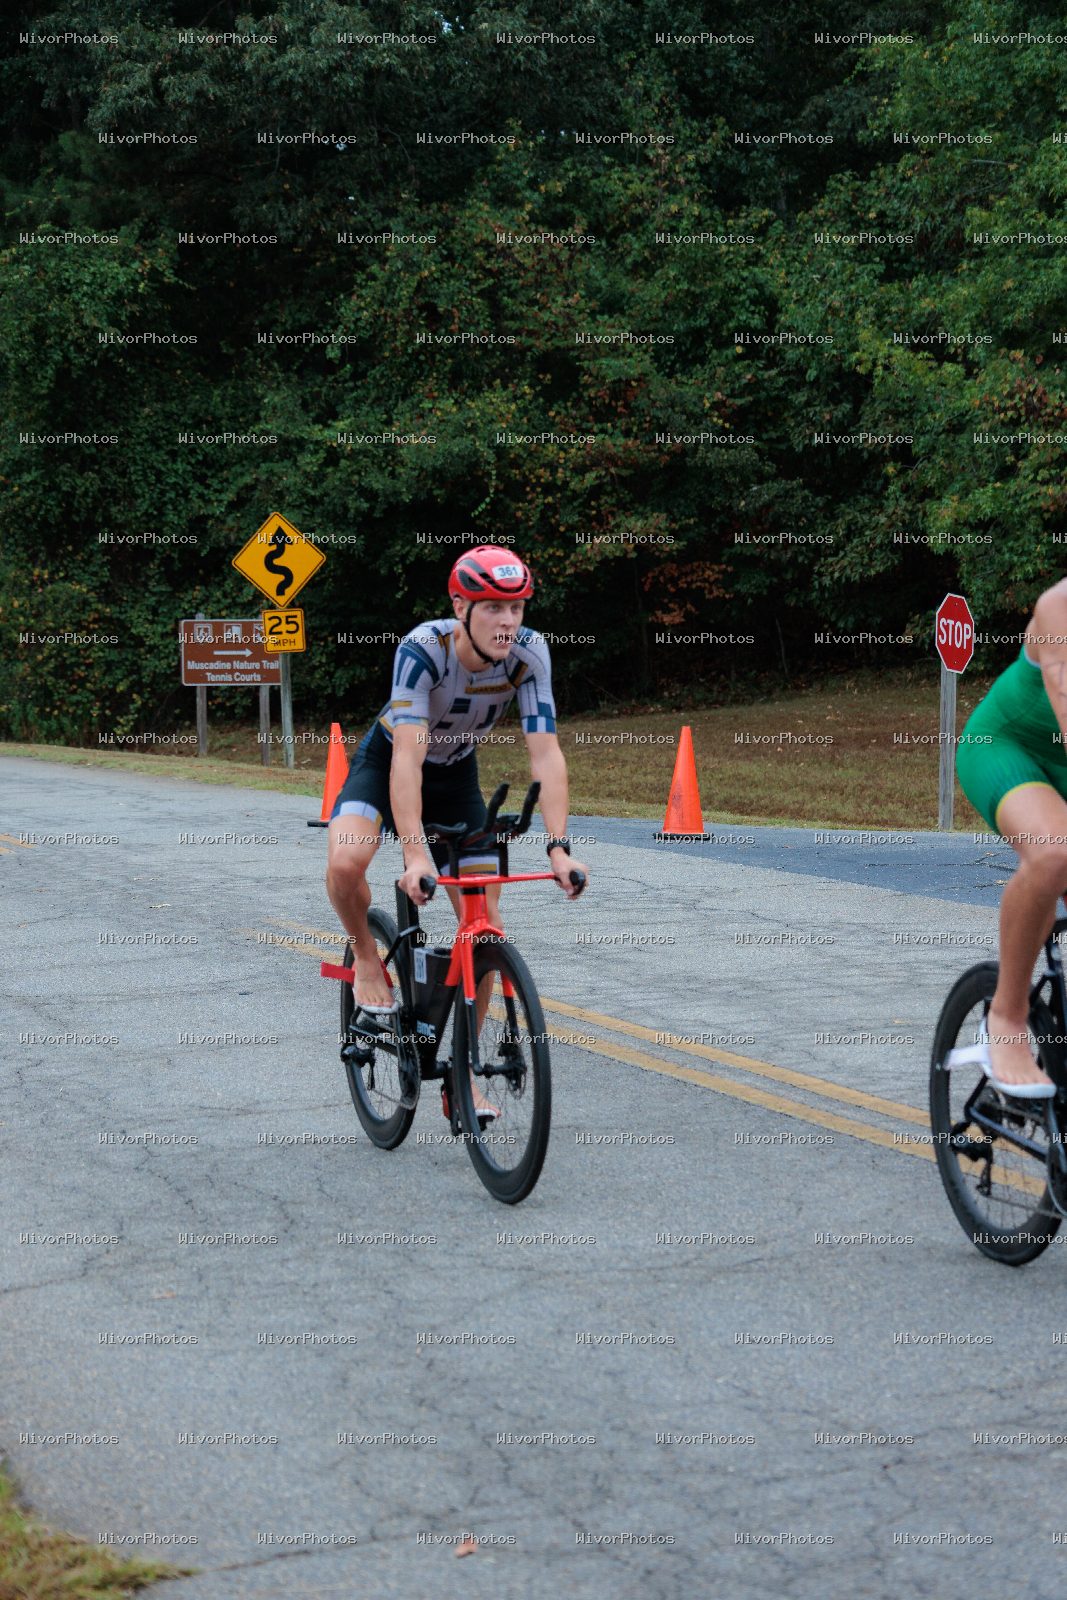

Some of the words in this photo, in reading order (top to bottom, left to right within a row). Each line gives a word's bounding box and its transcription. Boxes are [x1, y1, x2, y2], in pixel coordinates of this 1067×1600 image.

[497, 566, 518, 577] 361
[268, 615, 300, 635] 25
[938, 617, 972, 650] STOP
[273, 638, 297, 647] MPH
[187, 660, 231, 670] Muscadine
[233, 660, 261, 670] Nature
[262, 660, 280, 670] Trail
[206, 672, 233, 682] Tennis
[233, 672, 262, 682] Courts
